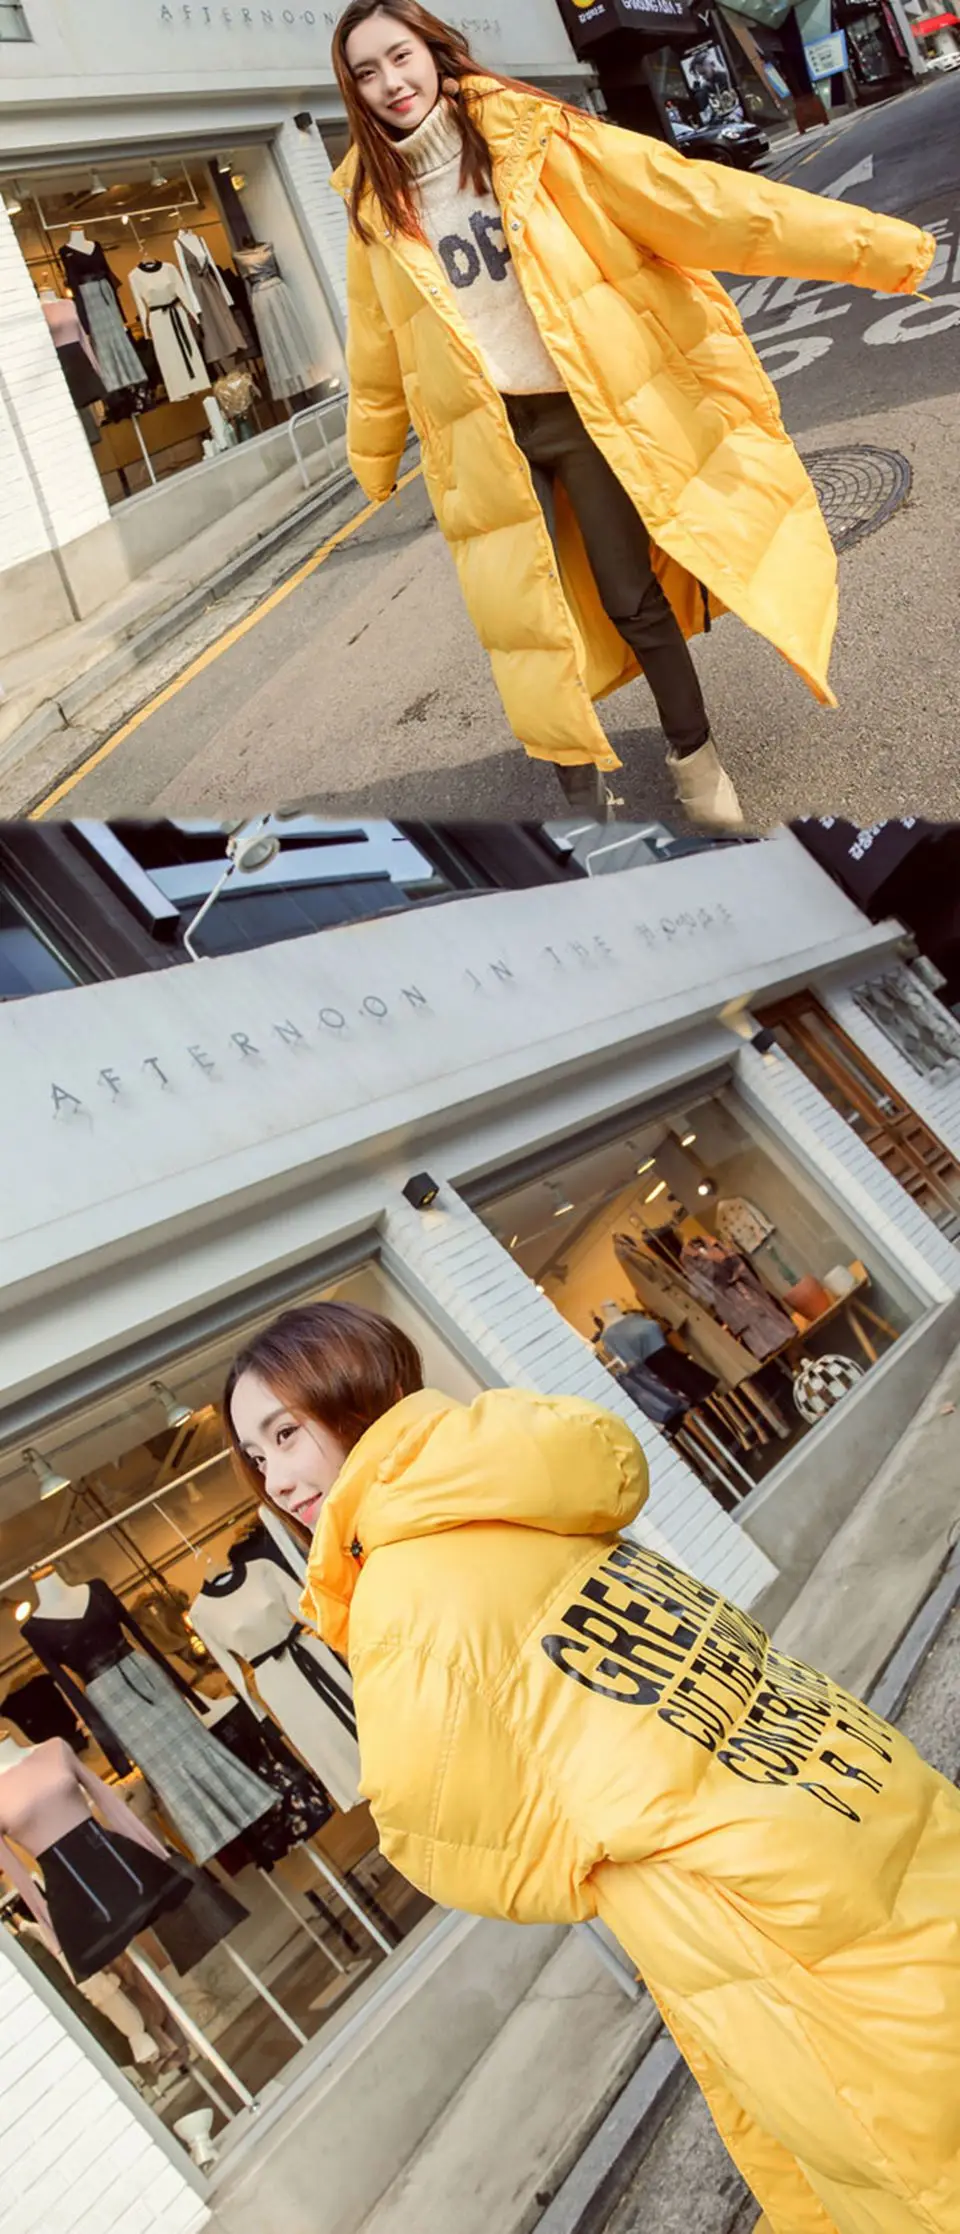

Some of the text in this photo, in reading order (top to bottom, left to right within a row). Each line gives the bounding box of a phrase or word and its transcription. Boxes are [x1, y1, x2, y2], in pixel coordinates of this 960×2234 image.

[160, 4, 337, 26] AFTERNOON
[49, 984, 429, 1111] AFTERNOON
[464, 959, 515, 988] IN
[544, 935, 613, 966] THE
[690, 1636, 764, 1708] THE
[657, 1676, 735, 1753] CUT
